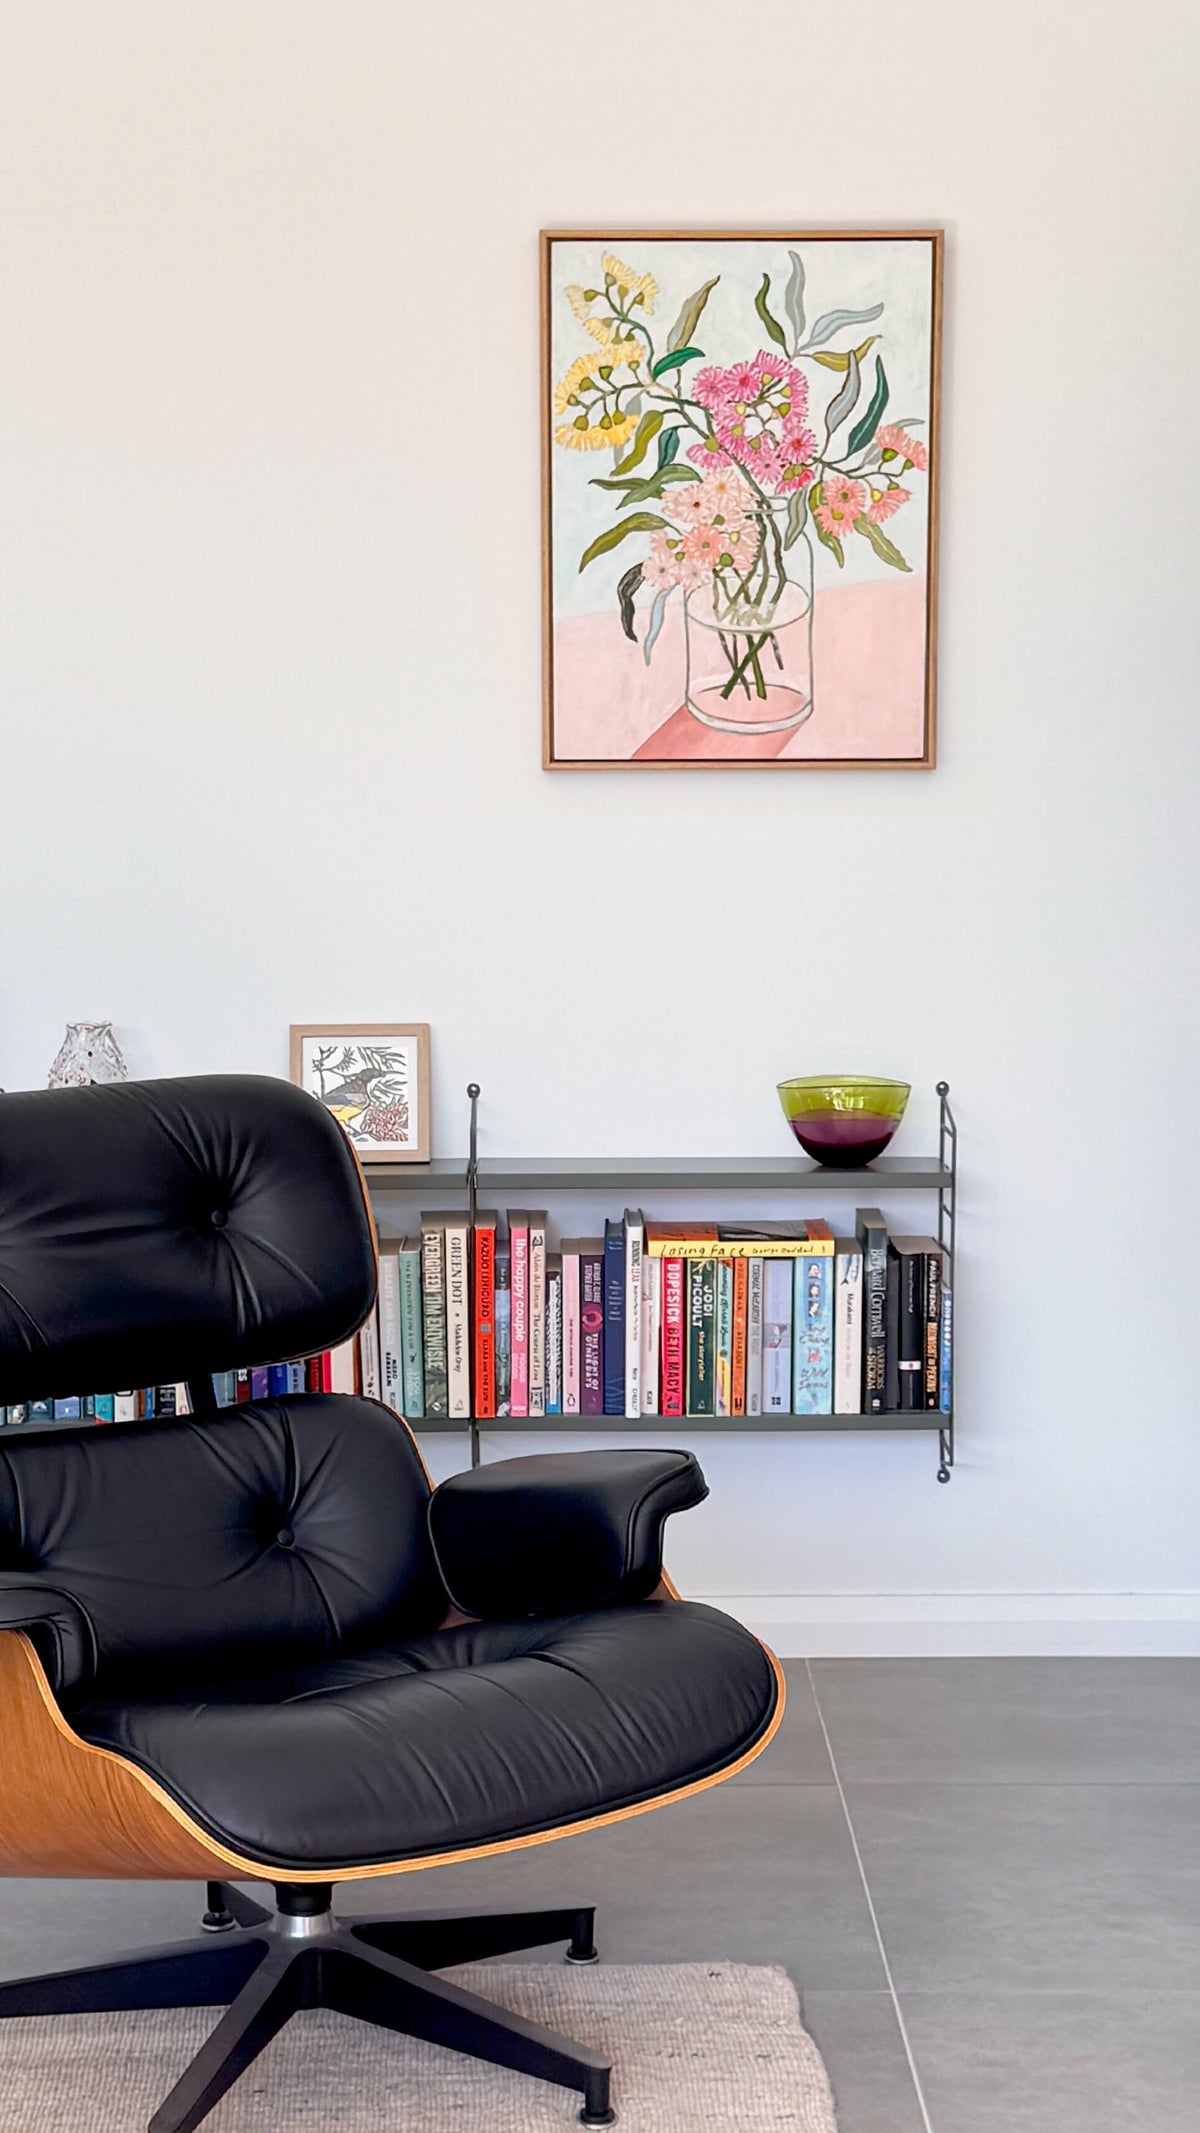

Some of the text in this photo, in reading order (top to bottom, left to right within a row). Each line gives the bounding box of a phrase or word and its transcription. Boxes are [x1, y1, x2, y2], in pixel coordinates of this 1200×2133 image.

[451, 1237, 462, 1278] GREEN
[660, 1244, 706, 1256] Losing
[710, 1244, 745, 1257] Face
[870, 1249, 885, 1290] Bernard
[424, 1234, 444, 1369] EVERGREEN TIM ENTWISLE
[452, 1280, 463, 1306] DOT
[480, 1237, 490, 1318] KAZUO ISHIGURO
[514, 1238, 526, 1342] the happy couple
[692, 1275, 703, 1328] PICOULT
[704, 1285, 713, 1317] JODI
[929, 1260, 937, 1317] PAUL FRENCH
[667, 1264, 680, 1394] DOPESICK BETH MACY
[870, 1292, 886, 1338] Cornwell
